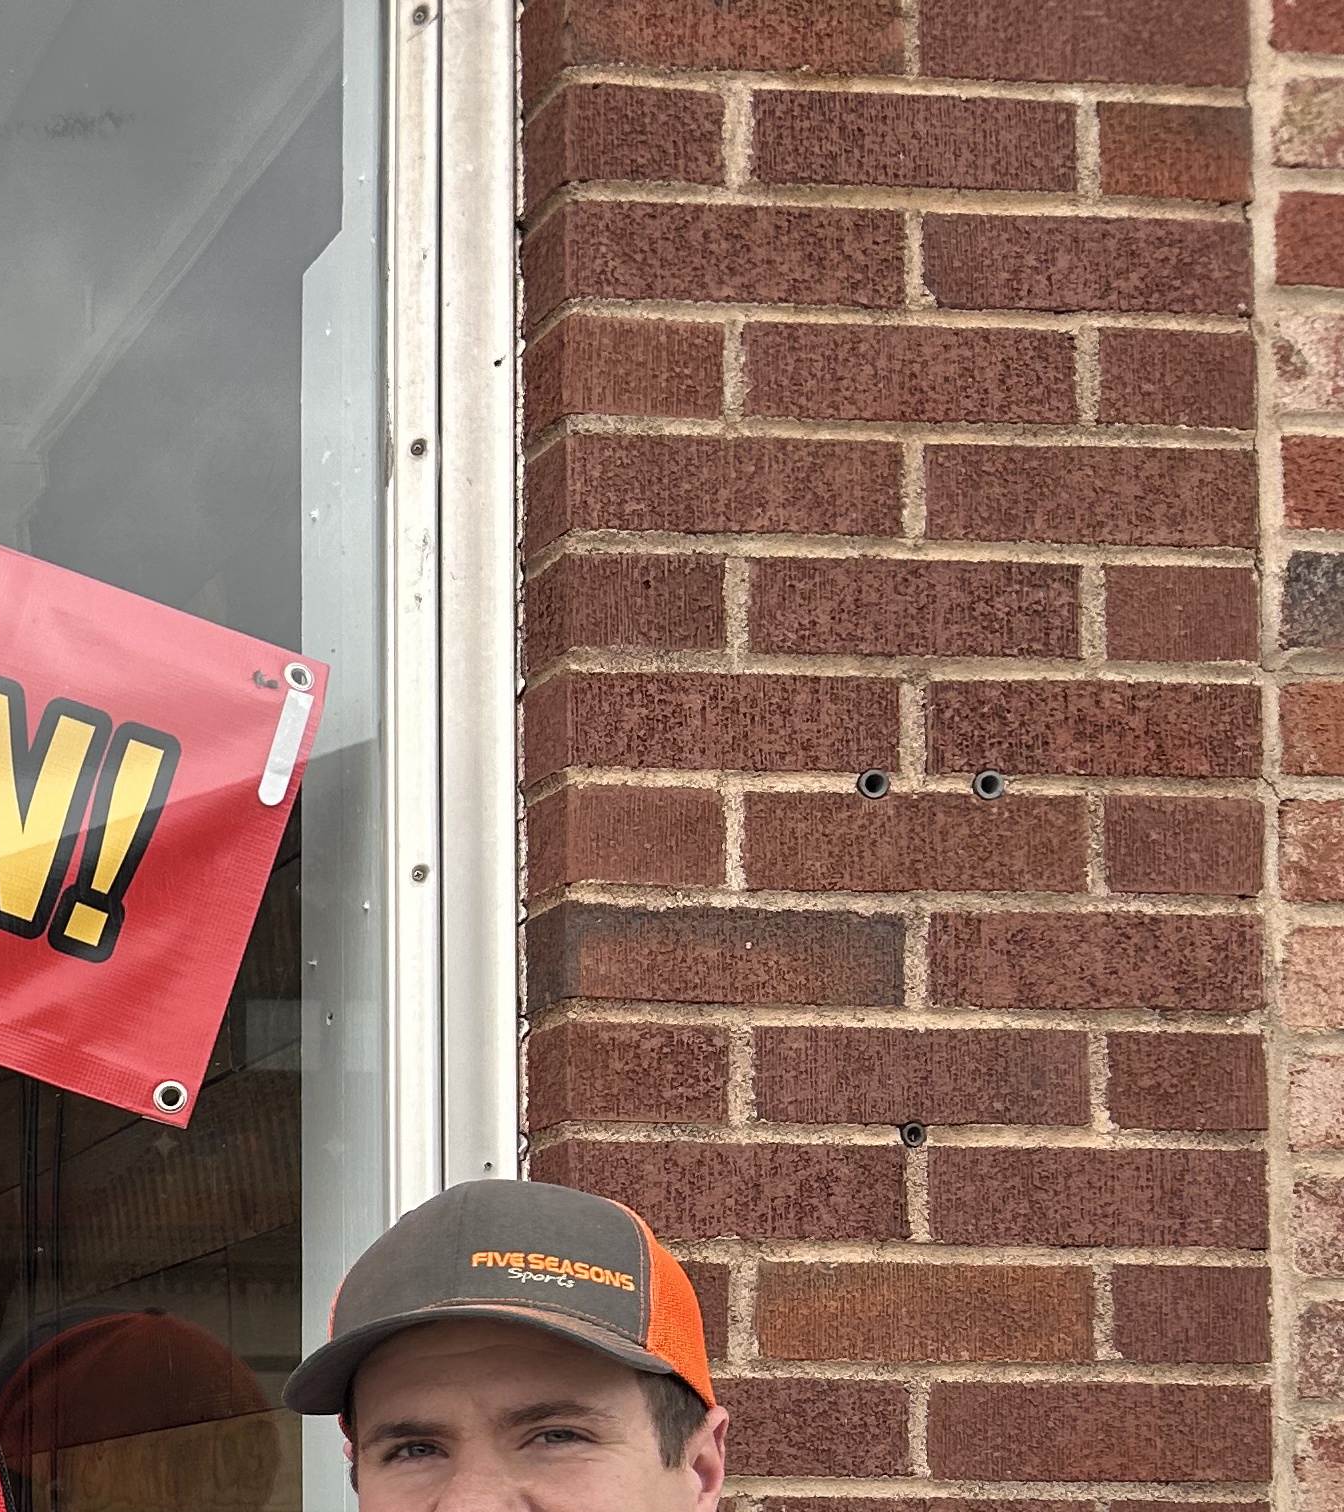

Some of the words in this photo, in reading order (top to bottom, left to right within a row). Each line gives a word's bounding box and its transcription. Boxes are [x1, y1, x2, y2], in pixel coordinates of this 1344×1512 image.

[471, 1251, 524, 1269] FIVE
[527, 1252, 636, 1292] SEASONS
[507, 1267, 576, 1289] Sports
